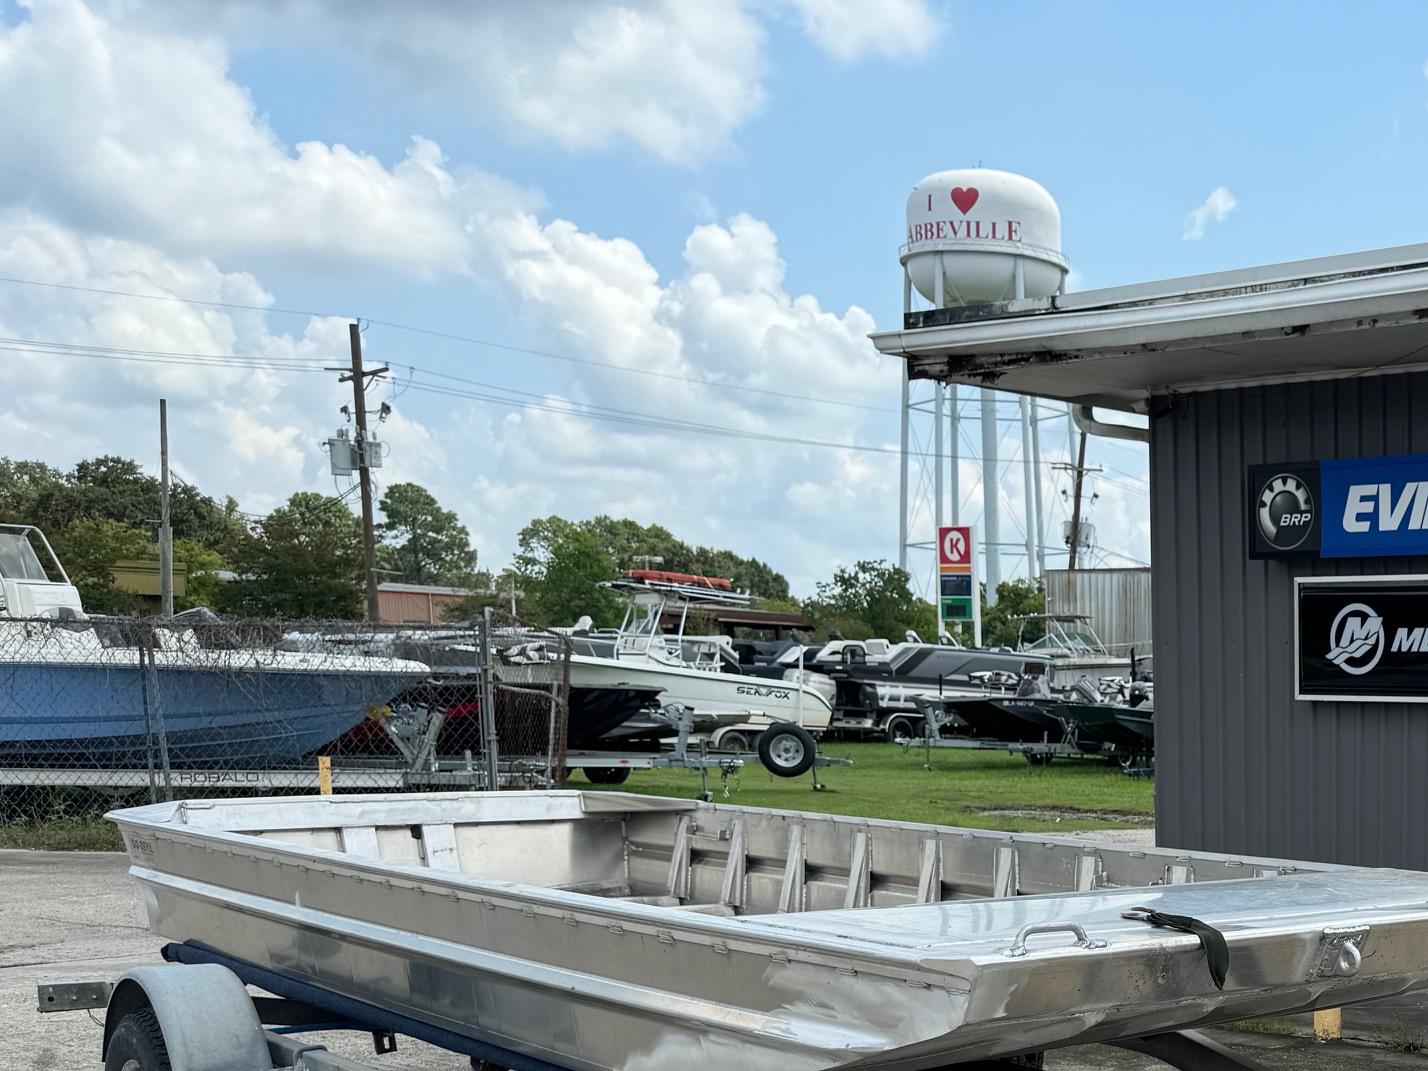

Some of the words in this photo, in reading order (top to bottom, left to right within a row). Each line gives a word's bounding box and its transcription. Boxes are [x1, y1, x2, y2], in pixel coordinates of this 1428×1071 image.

[927, 194, 932, 212] I
[908, 220, 1023, 245] ABBEVILLE
[1280, 513, 1311, 526] BRP
[180, 772, 260, 783] ROBALO
